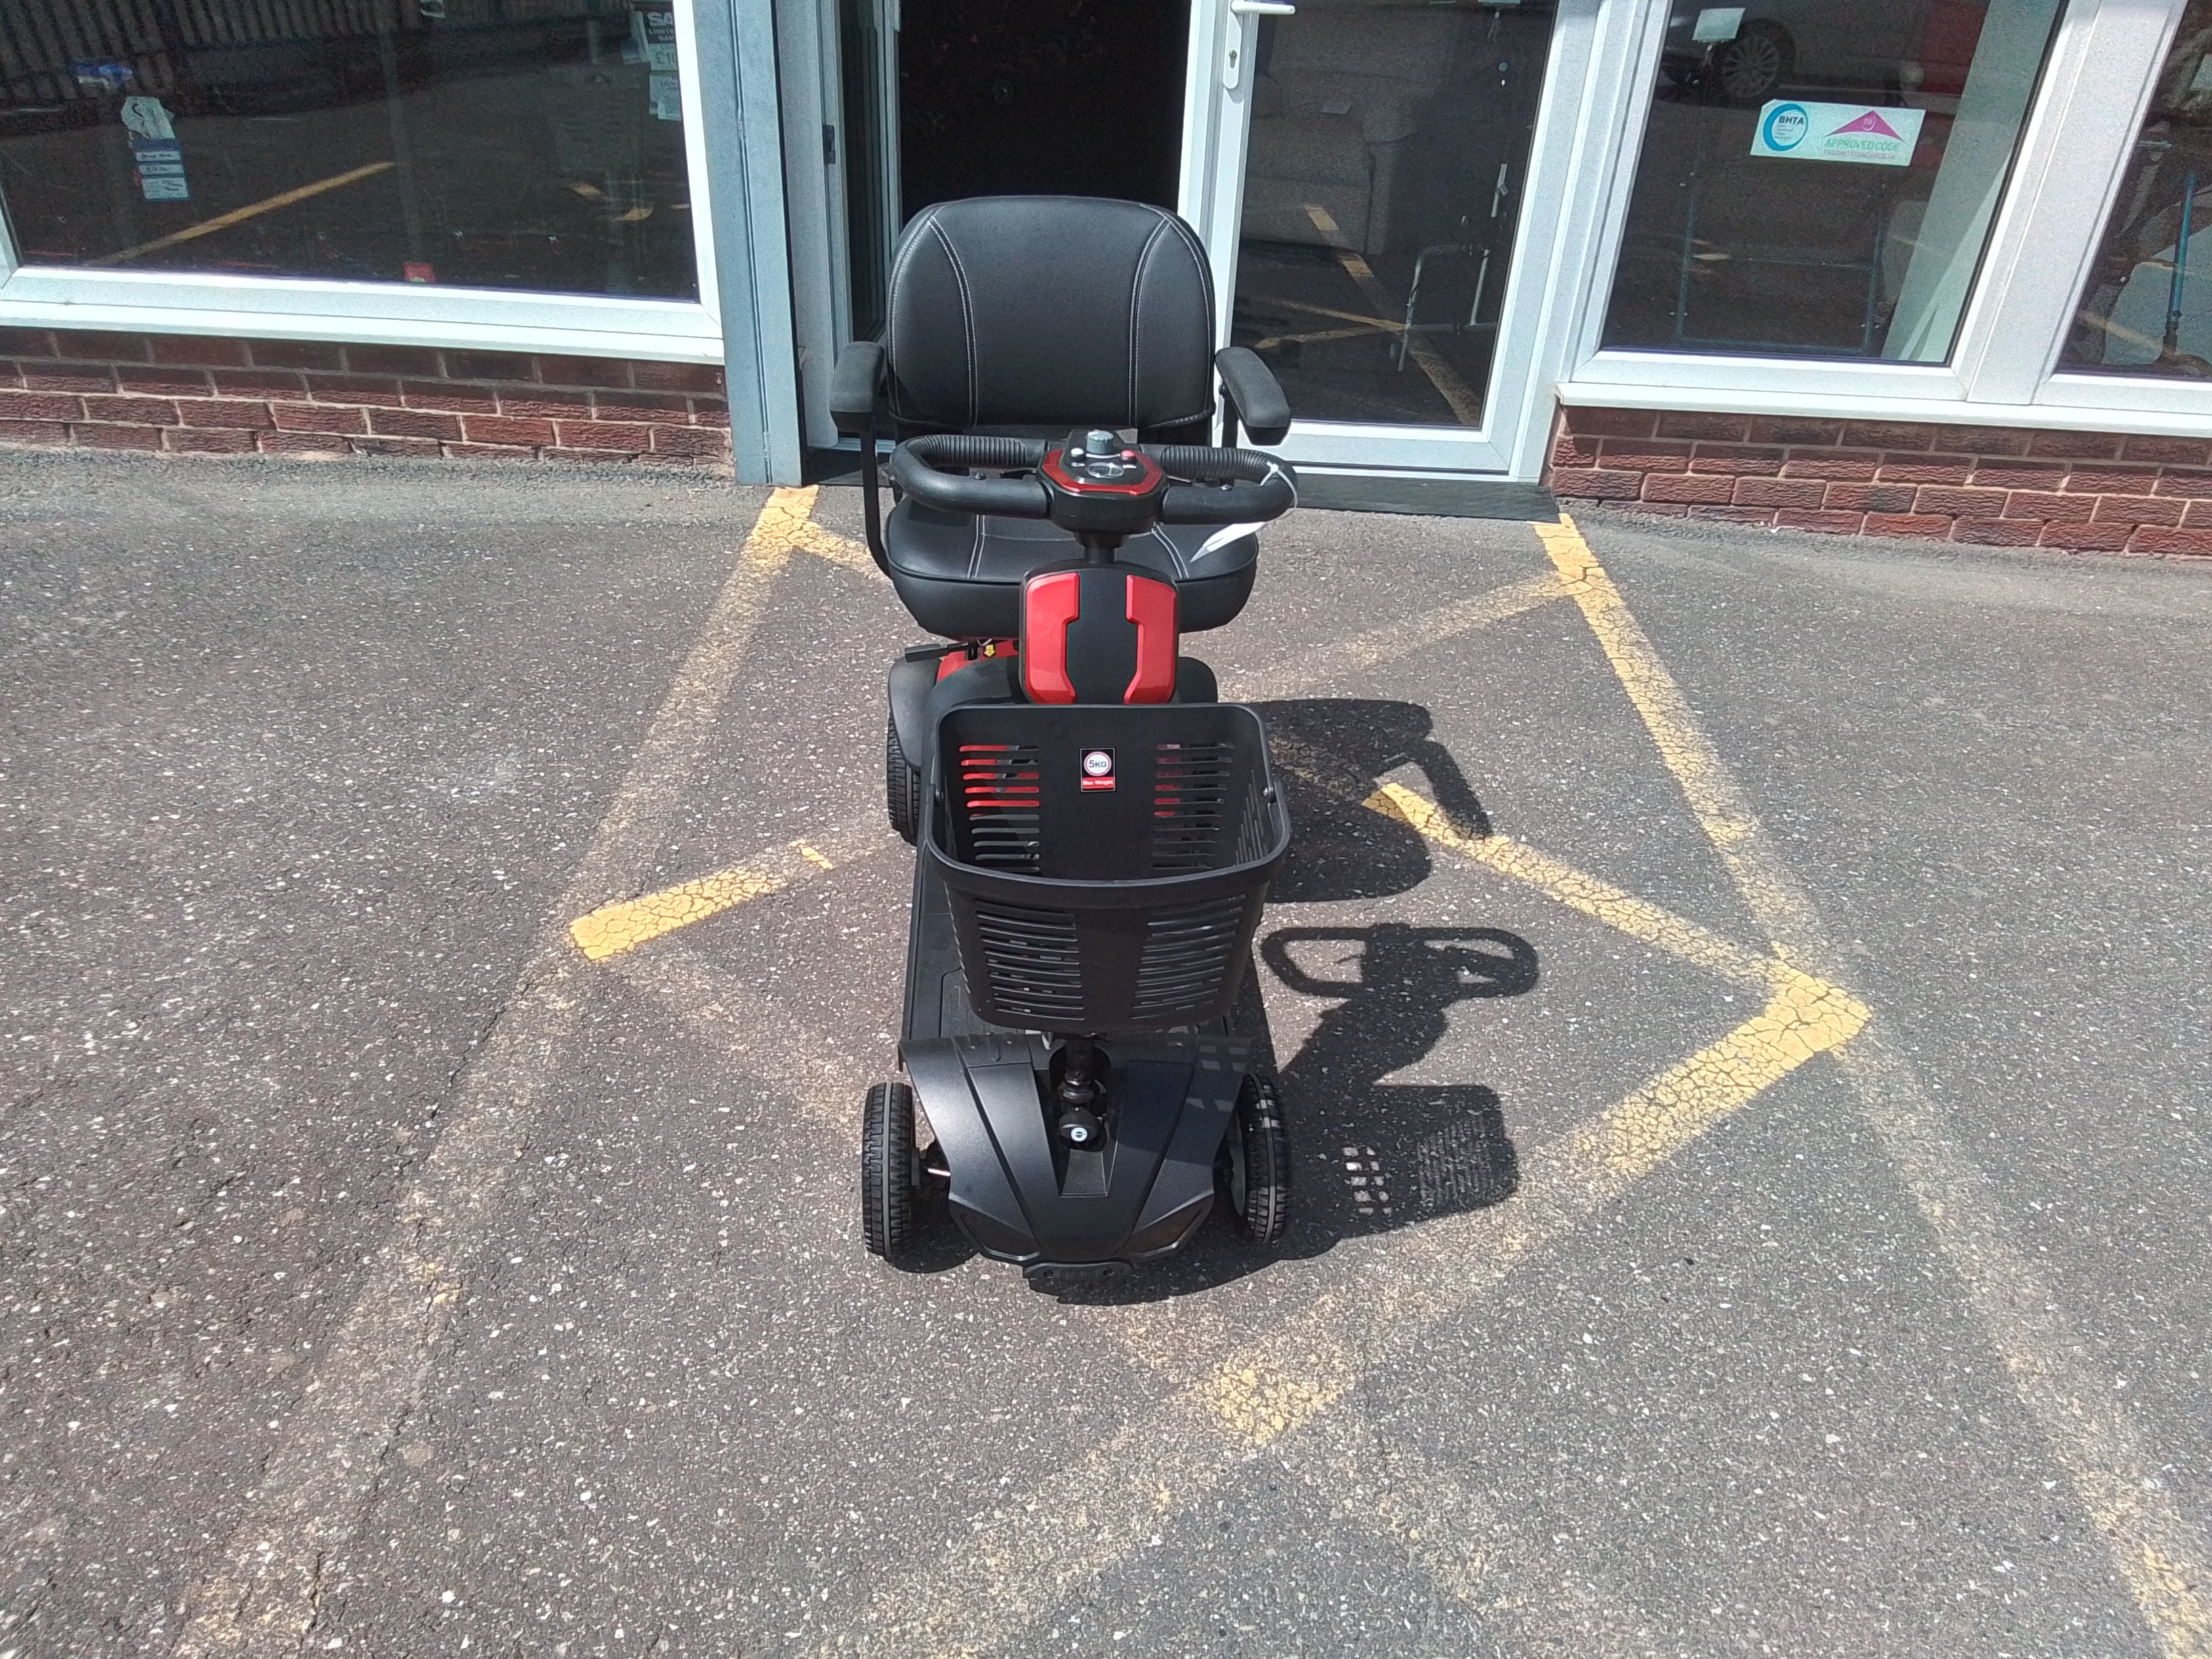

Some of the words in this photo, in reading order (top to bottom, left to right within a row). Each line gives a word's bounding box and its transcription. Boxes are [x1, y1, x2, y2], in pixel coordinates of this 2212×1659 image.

[1778, 116, 1804, 125] BHTA
[1824, 138, 1874, 150] APPROVED
[1875, 141, 1898, 151] CODE
[1088, 760, 1107, 768] 5KG
